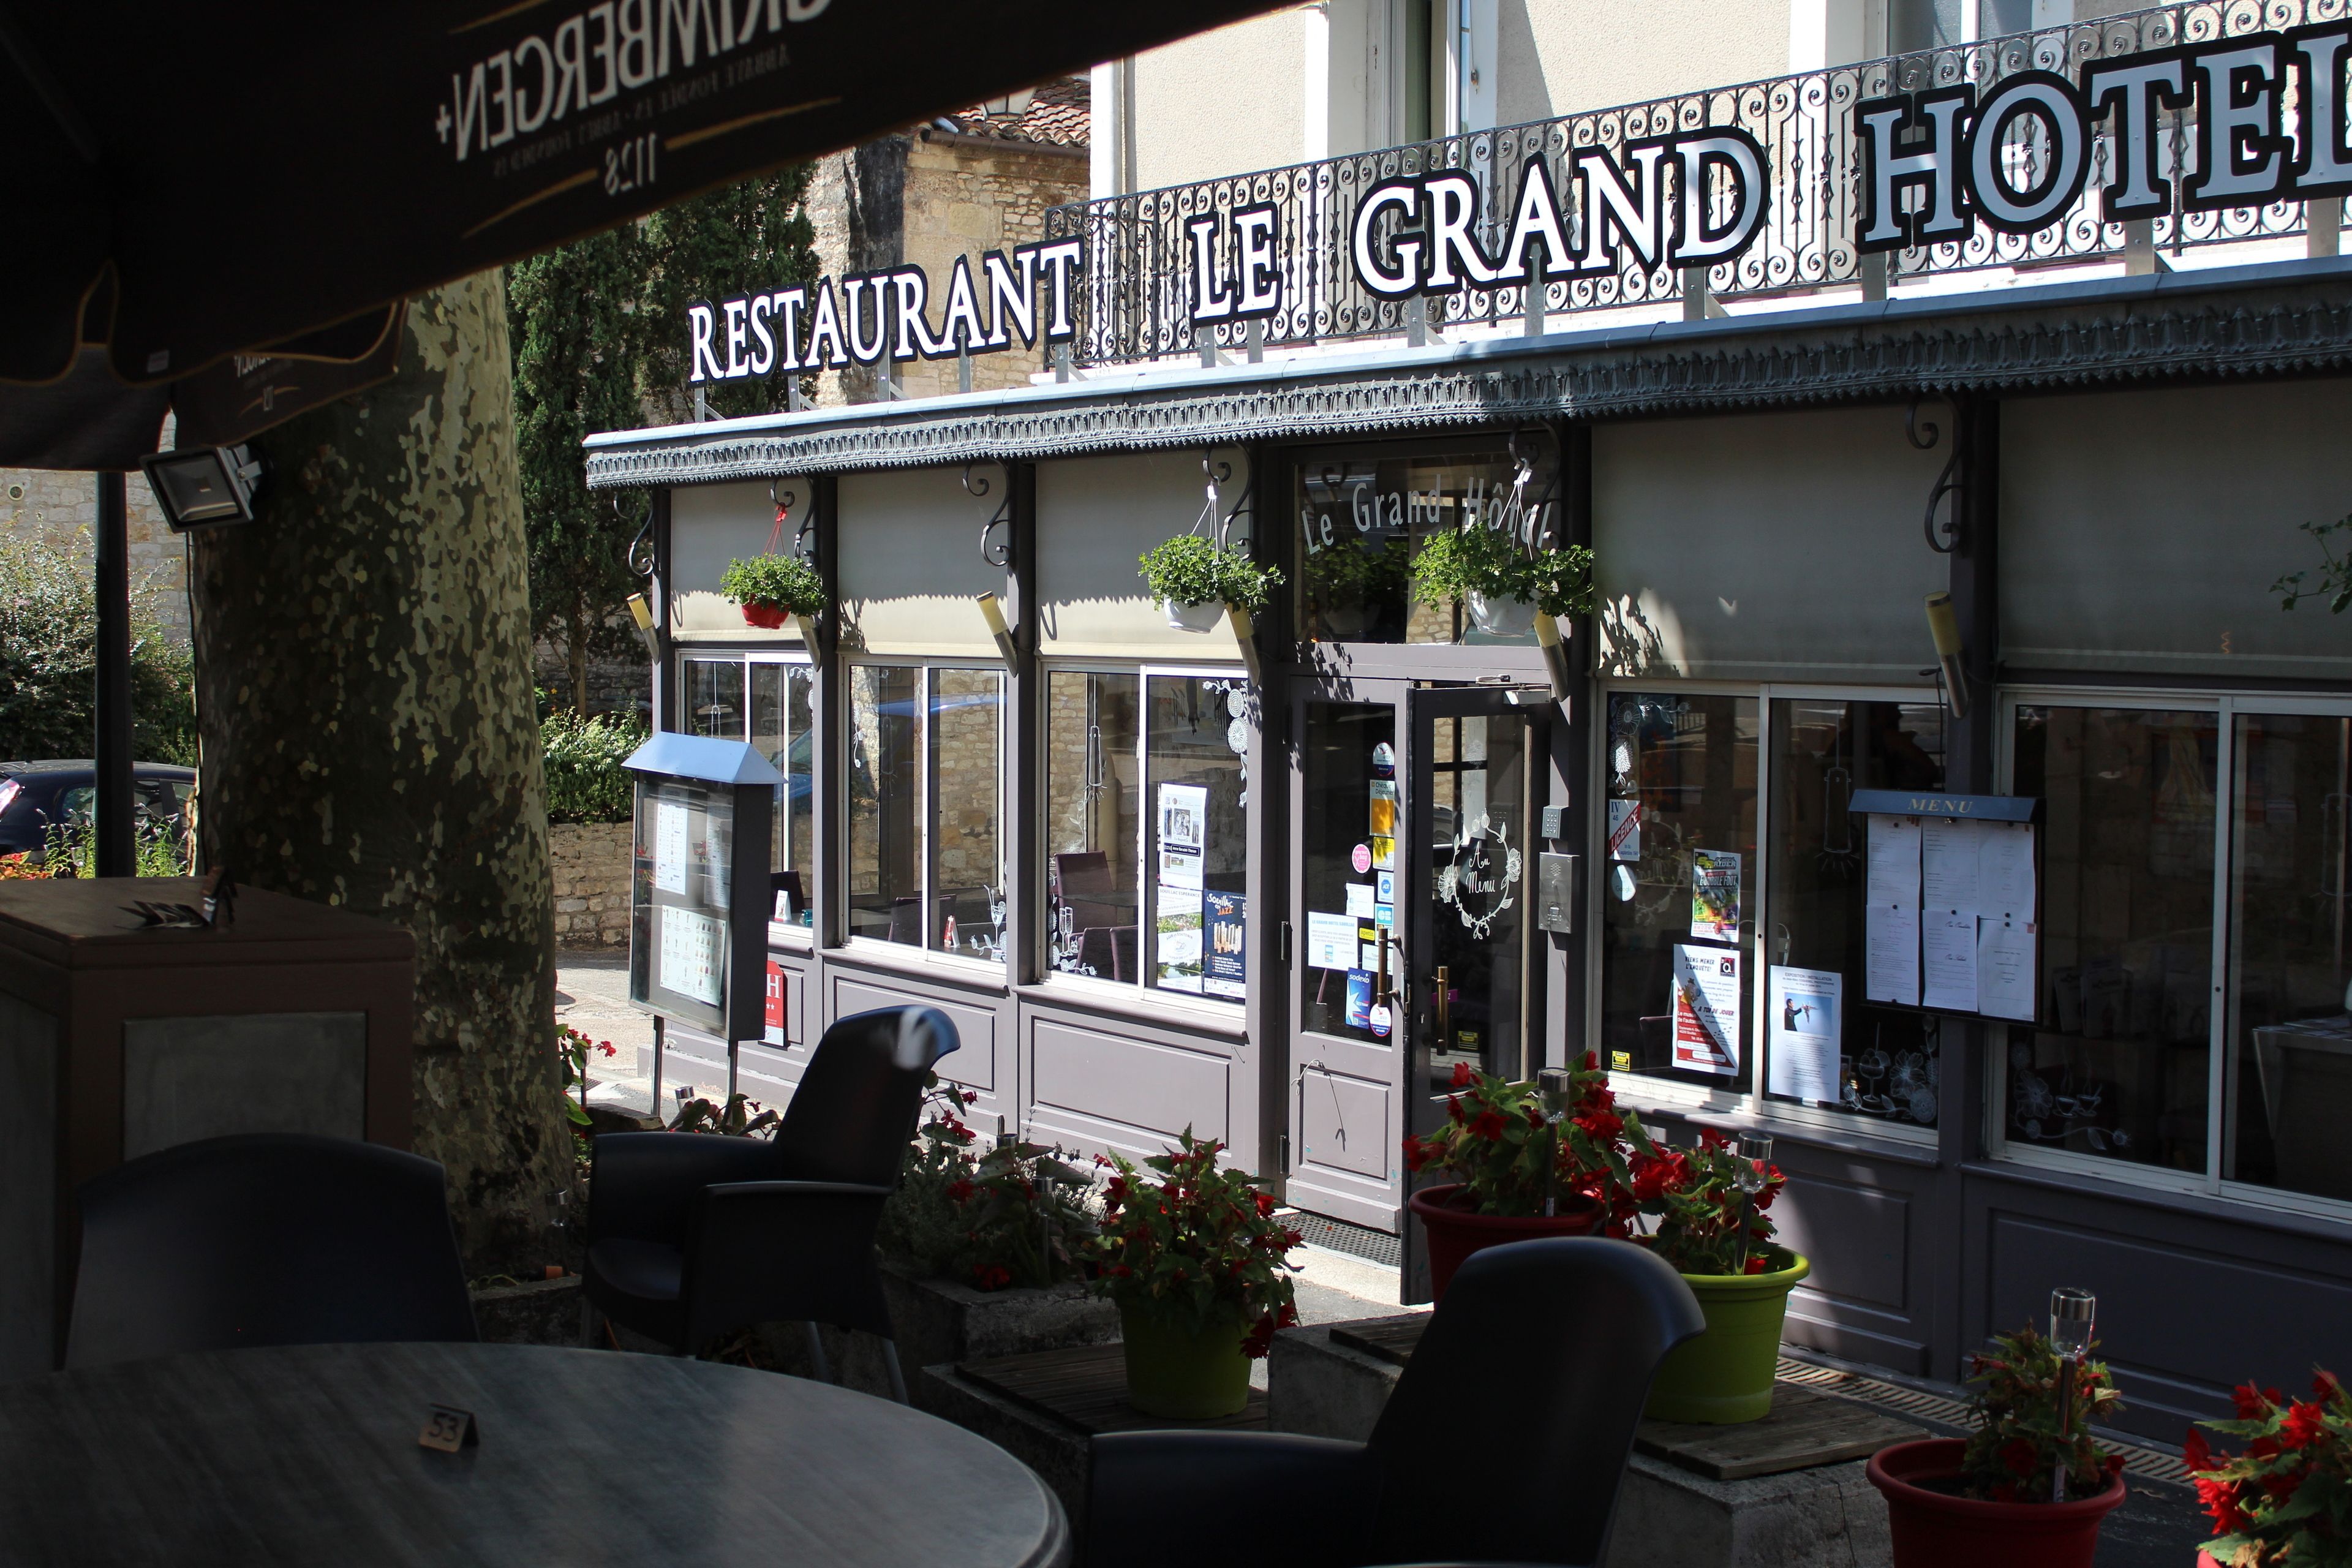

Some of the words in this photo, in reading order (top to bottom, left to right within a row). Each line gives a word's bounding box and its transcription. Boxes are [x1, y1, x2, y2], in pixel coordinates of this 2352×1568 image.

[689, 238, 1083, 386] RESTAURANT
[1188, 205, 1280, 323] LE
[1352, 130, 1768, 298] GRAND
[1858, 26, 2352, 250] HOTEL
[1302, 509, 1334, 555] Le
[1352, 473, 1441, 532] Grand
[1611, 802, 1620, 813] IV
[1907, 798, 1975, 813] MENU
[1611, 808, 1638, 853] LICENCE
[1469, 841, 1490, 869] Au
[1465, 870, 1496, 894] Menu
[1724, 874, 1737, 886] FOOT
[1217, 907, 1233, 916] JAZZ
[766, 973, 781, 999] H
[1349, 974, 1370, 983] sodexo
[428, 1411, 459, 1442] 53
